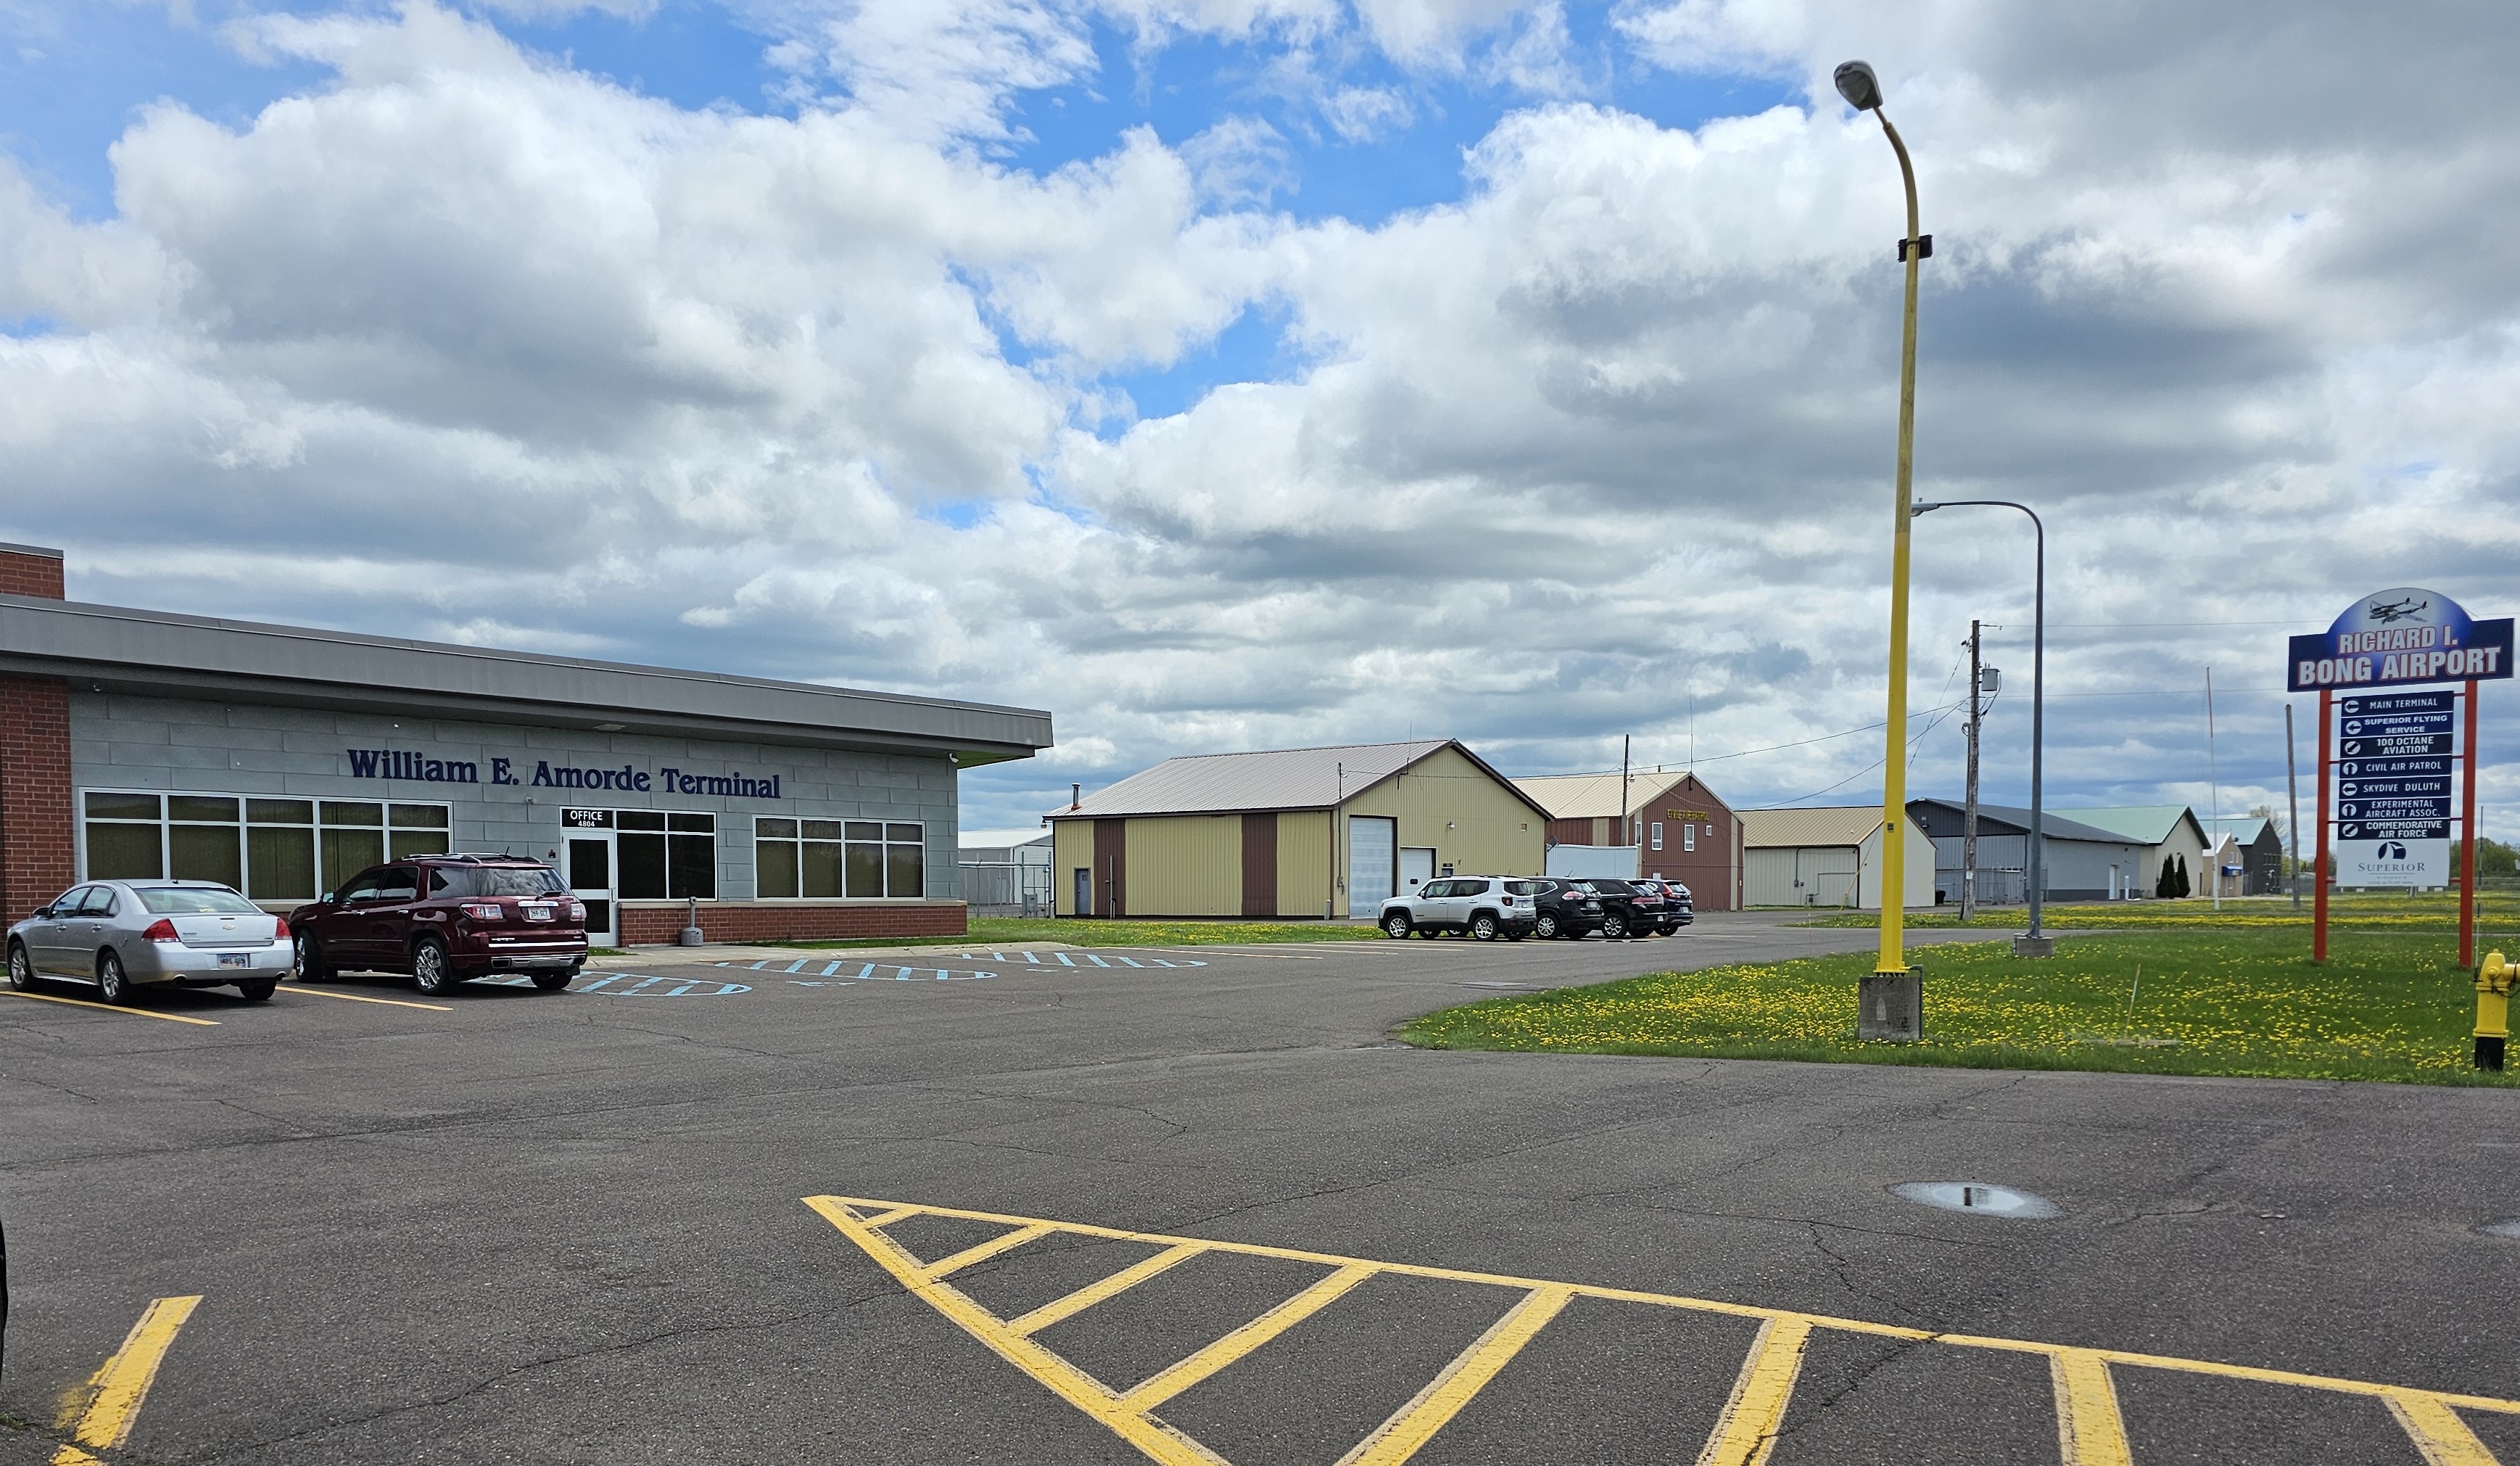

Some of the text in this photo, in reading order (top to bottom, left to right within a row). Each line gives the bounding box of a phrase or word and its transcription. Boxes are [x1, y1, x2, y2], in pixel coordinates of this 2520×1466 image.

[2339, 625, 2458, 654] RICHARD I.
[2299, 646, 2501, 685] BONG AIRPORT
[2369, 698, 2438, 709] MAIN TERMINAL
[2364, 715, 2447, 725] SUPERIOR FLYING
[2377, 736, 2434, 746] 100 OCTANE
[2383, 745, 2428, 754] AVIATION
[2366, 761, 2442, 772] CIVIL AIR PATROL
[347, 749, 781, 799] William E. Amorde Terminal
[2363, 783, 2440, 793] SKYDIVE DULUTH
[2371, 799, 2434, 809] EXPERIMENTAL
[570, 810, 603, 820] OFFICE
[2366, 808, 2441, 818] AIRCRAFT ASSOC.
[2366, 820, 2442, 830] COMMEMORATIVE
[2379, 829, 2427, 839] AIR FORCE
[2358, 862, 2426, 872] SUPERIOR
